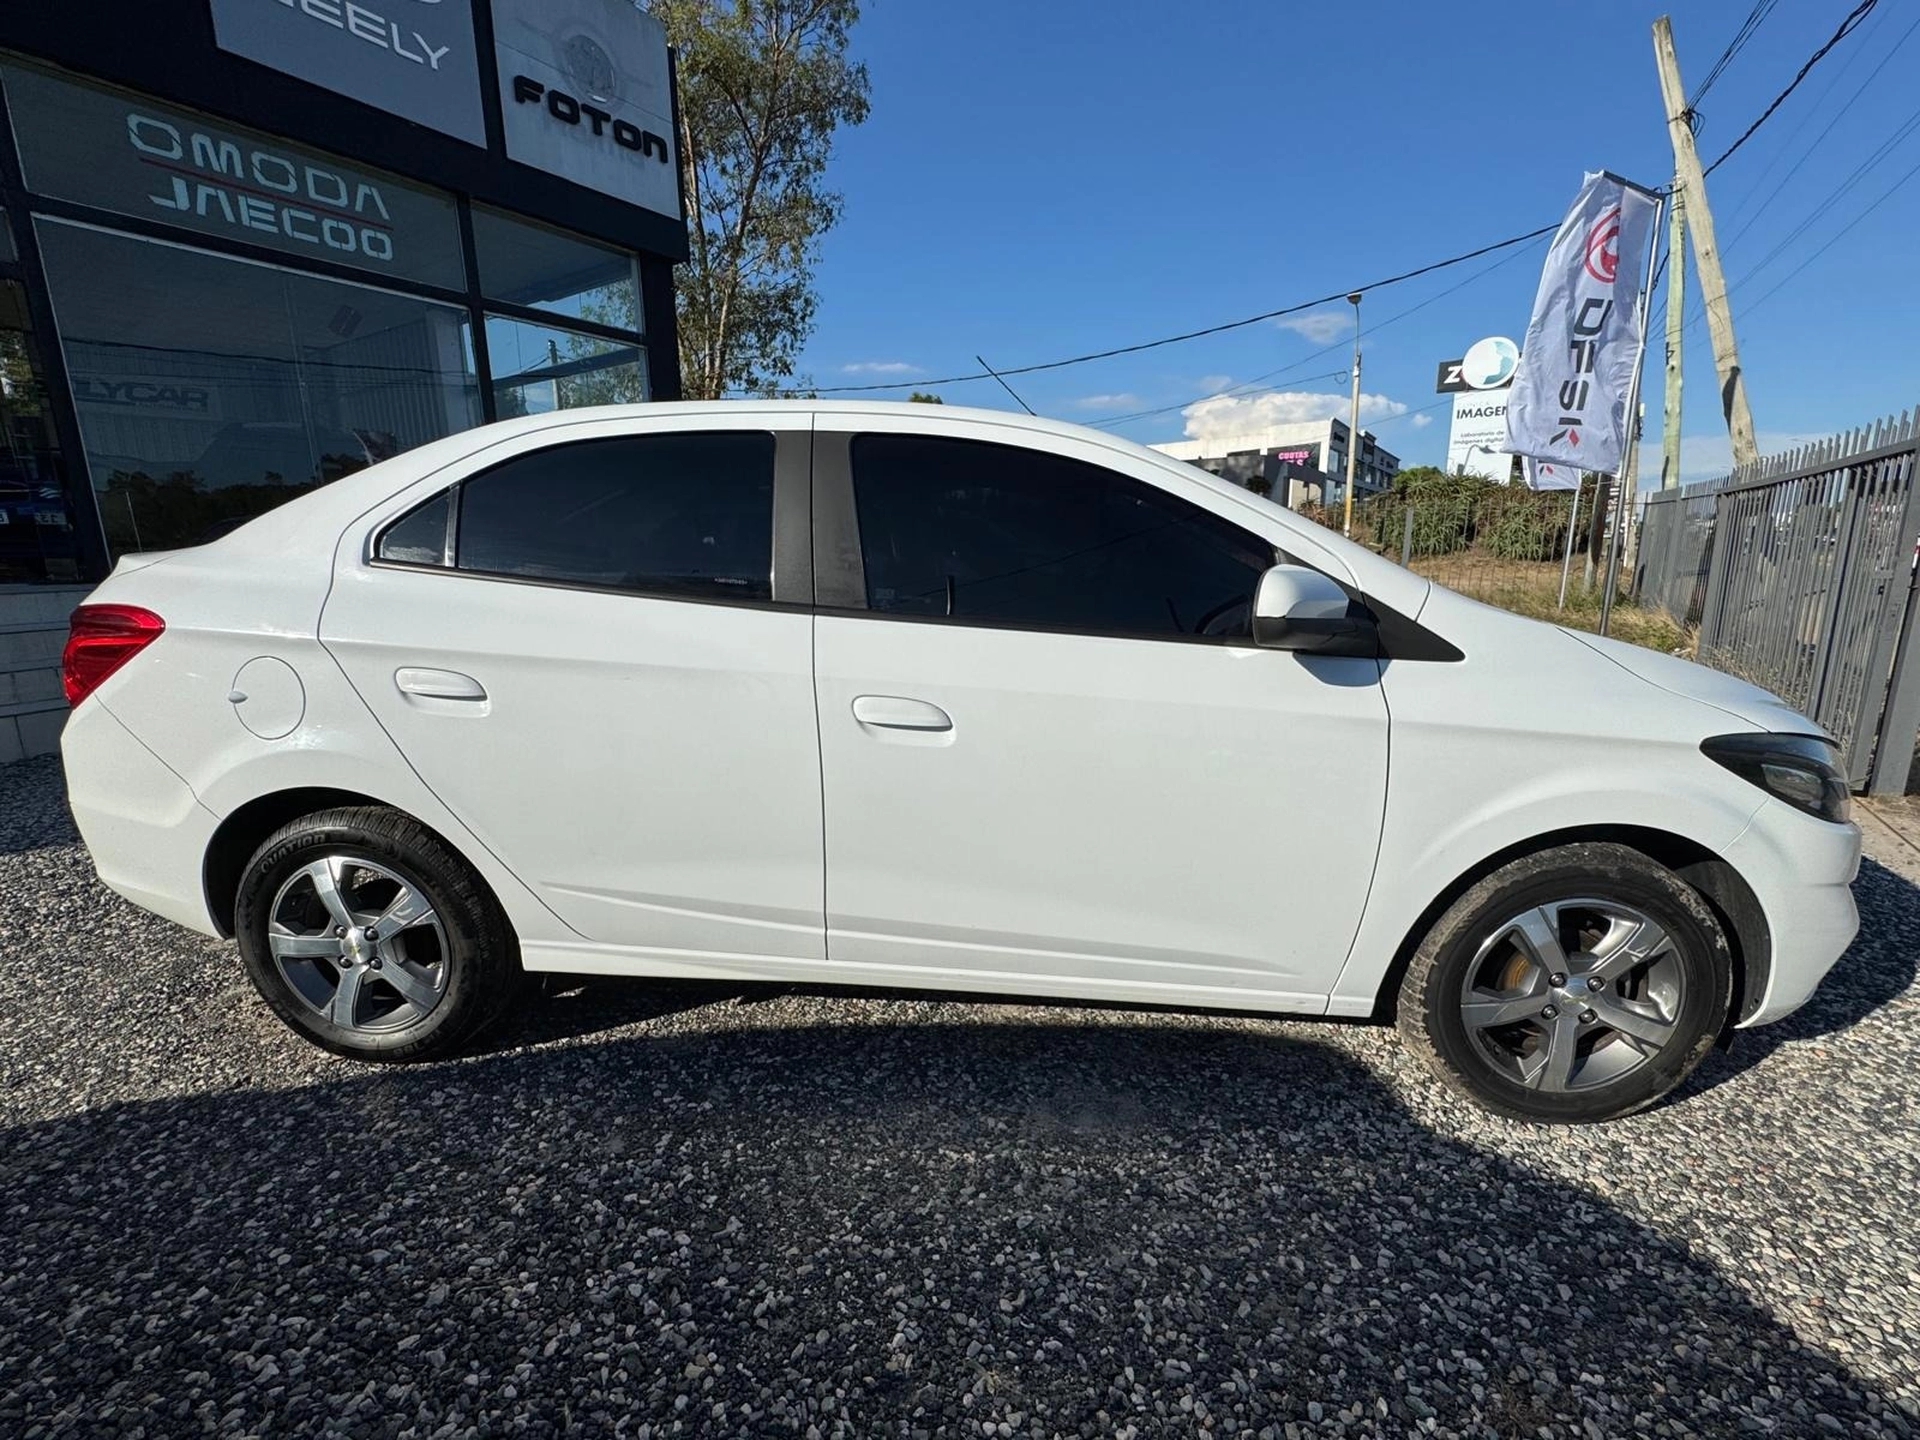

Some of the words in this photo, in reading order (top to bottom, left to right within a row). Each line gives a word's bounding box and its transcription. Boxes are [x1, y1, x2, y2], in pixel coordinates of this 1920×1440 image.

[277, 0, 450, 71] EELY
[513, 75, 668, 164] FOTON
[126, 113, 391, 221] OMODA
[147, 176, 393, 261] JAECOO
